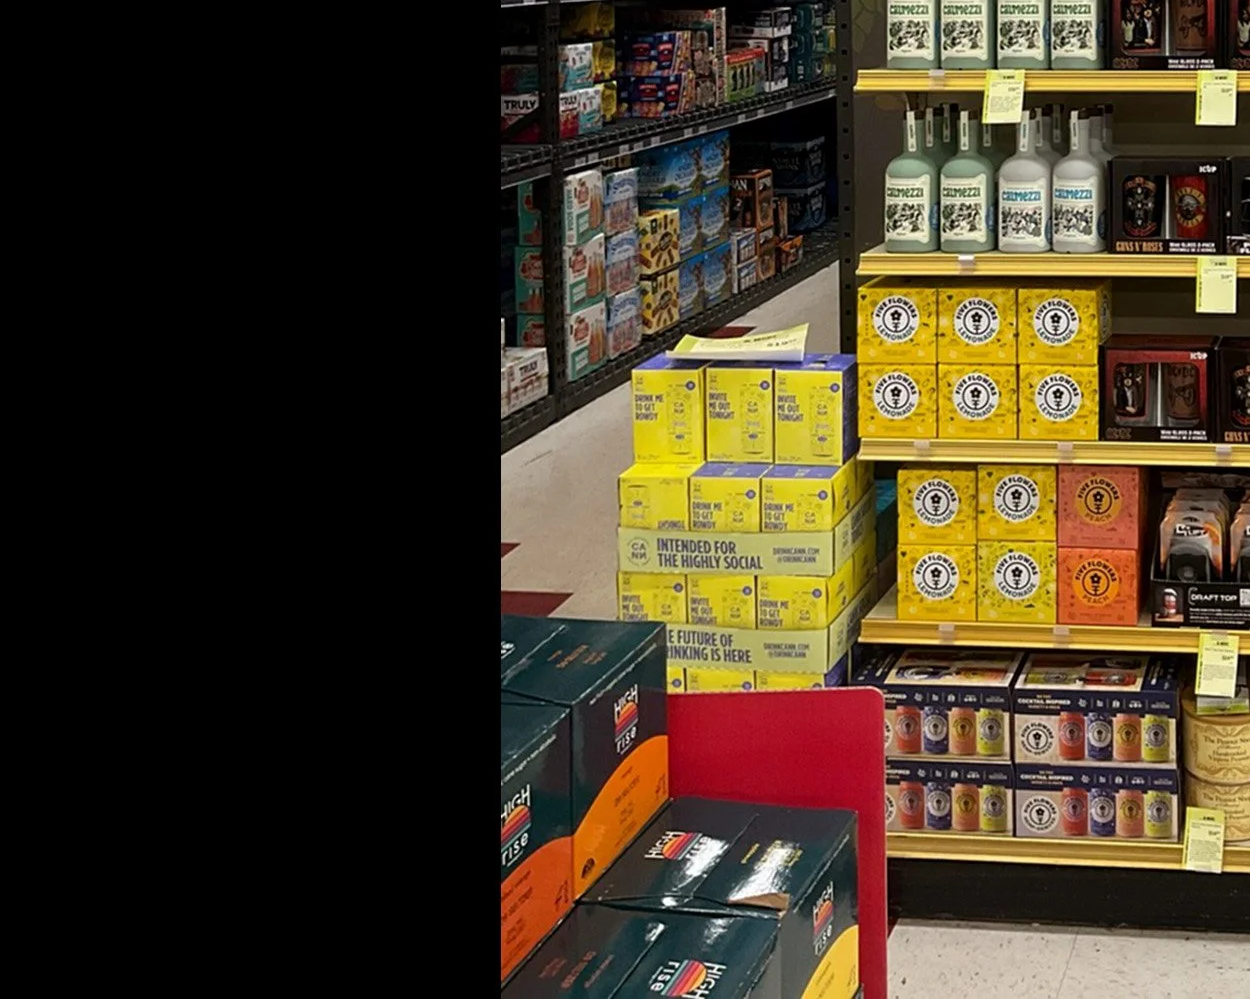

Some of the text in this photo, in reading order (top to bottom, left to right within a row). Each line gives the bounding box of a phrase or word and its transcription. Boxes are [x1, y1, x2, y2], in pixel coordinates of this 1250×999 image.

[875, 295, 917, 318] FIVE FLOWERS
[878, 325, 916, 342] LEMONADE
[657, 538, 737, 555] INTENDED FOR
[658, 553, 764, 571] THE HIGHLY SOCIAL
[1191, 594, 1238, 602] DRAFT TOP
[677, 631, 717, 647] FUTURE
[719, 634, 733, 648] OF
[711, 649, 721, 662] IS
[724, 650, 752, 663] HERE
[614, 684, 639, 723] HIGH
[617, 726, 638, 753] rise
[501, 832, 529, 865] rise
